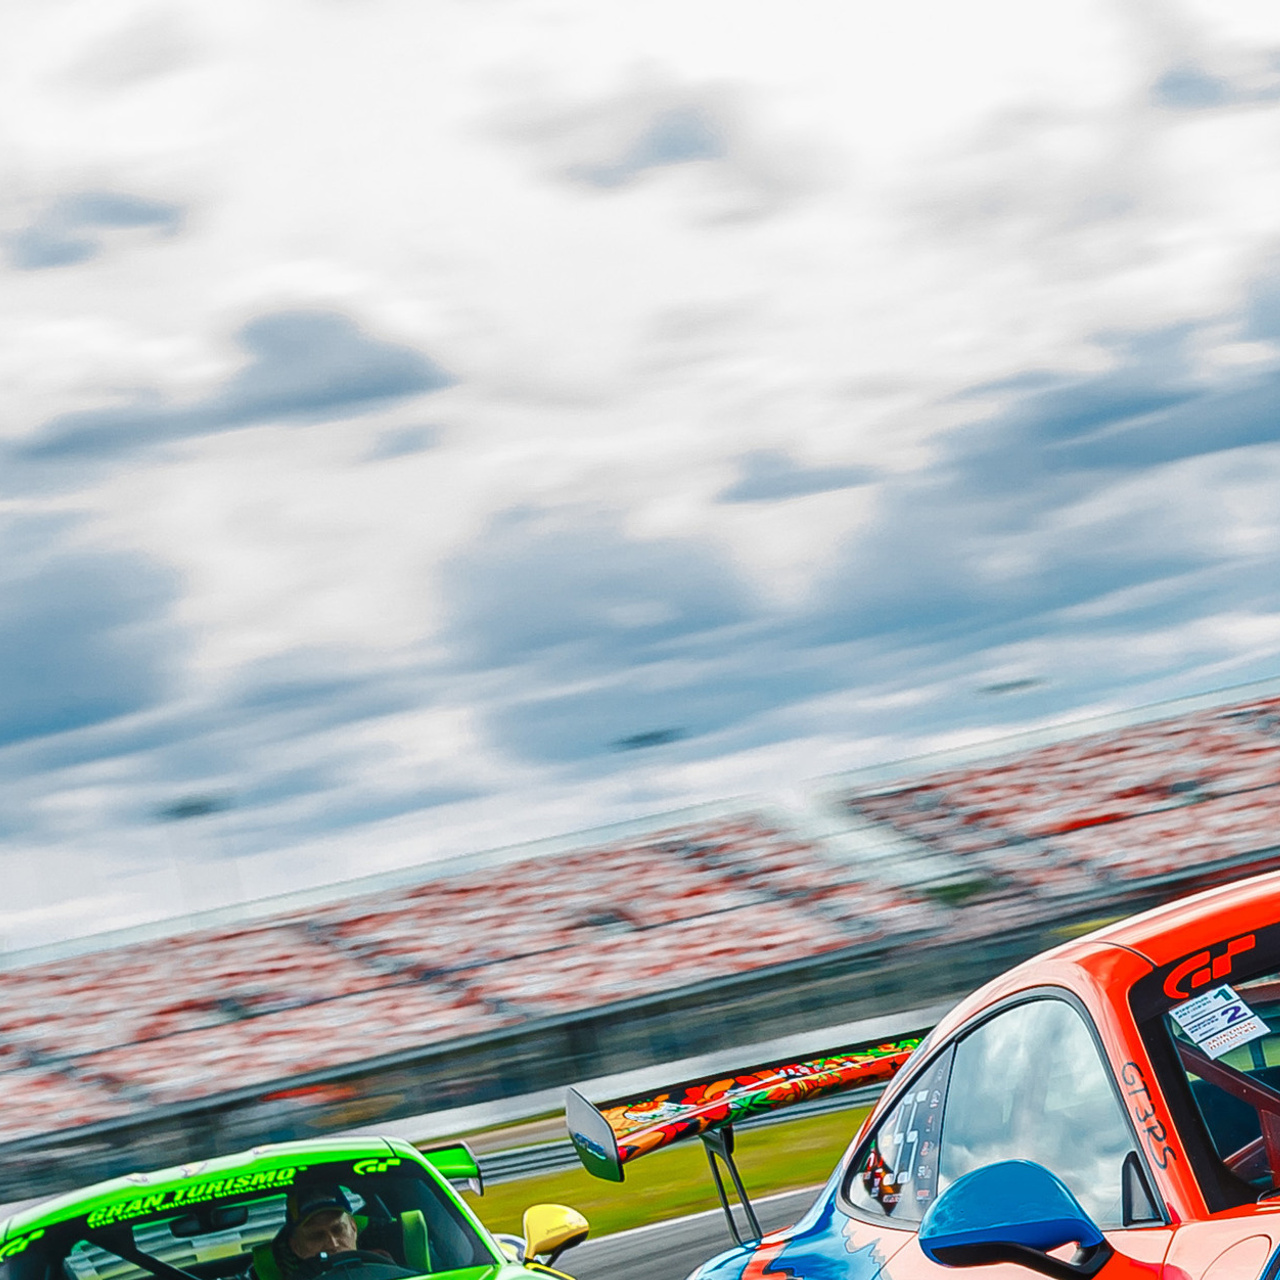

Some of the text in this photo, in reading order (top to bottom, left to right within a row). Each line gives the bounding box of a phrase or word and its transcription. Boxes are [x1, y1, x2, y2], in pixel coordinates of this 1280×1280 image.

[1213, 988, 1233, 1001] 1
[1220, 1005, 1248, 1024] 2
[1121, 1061, 1177, 1170] GT3RS
[86, 1167, 296, 1224] GRAN TURISMO
[214, 1179, 295, 1199] SIMULATOR
